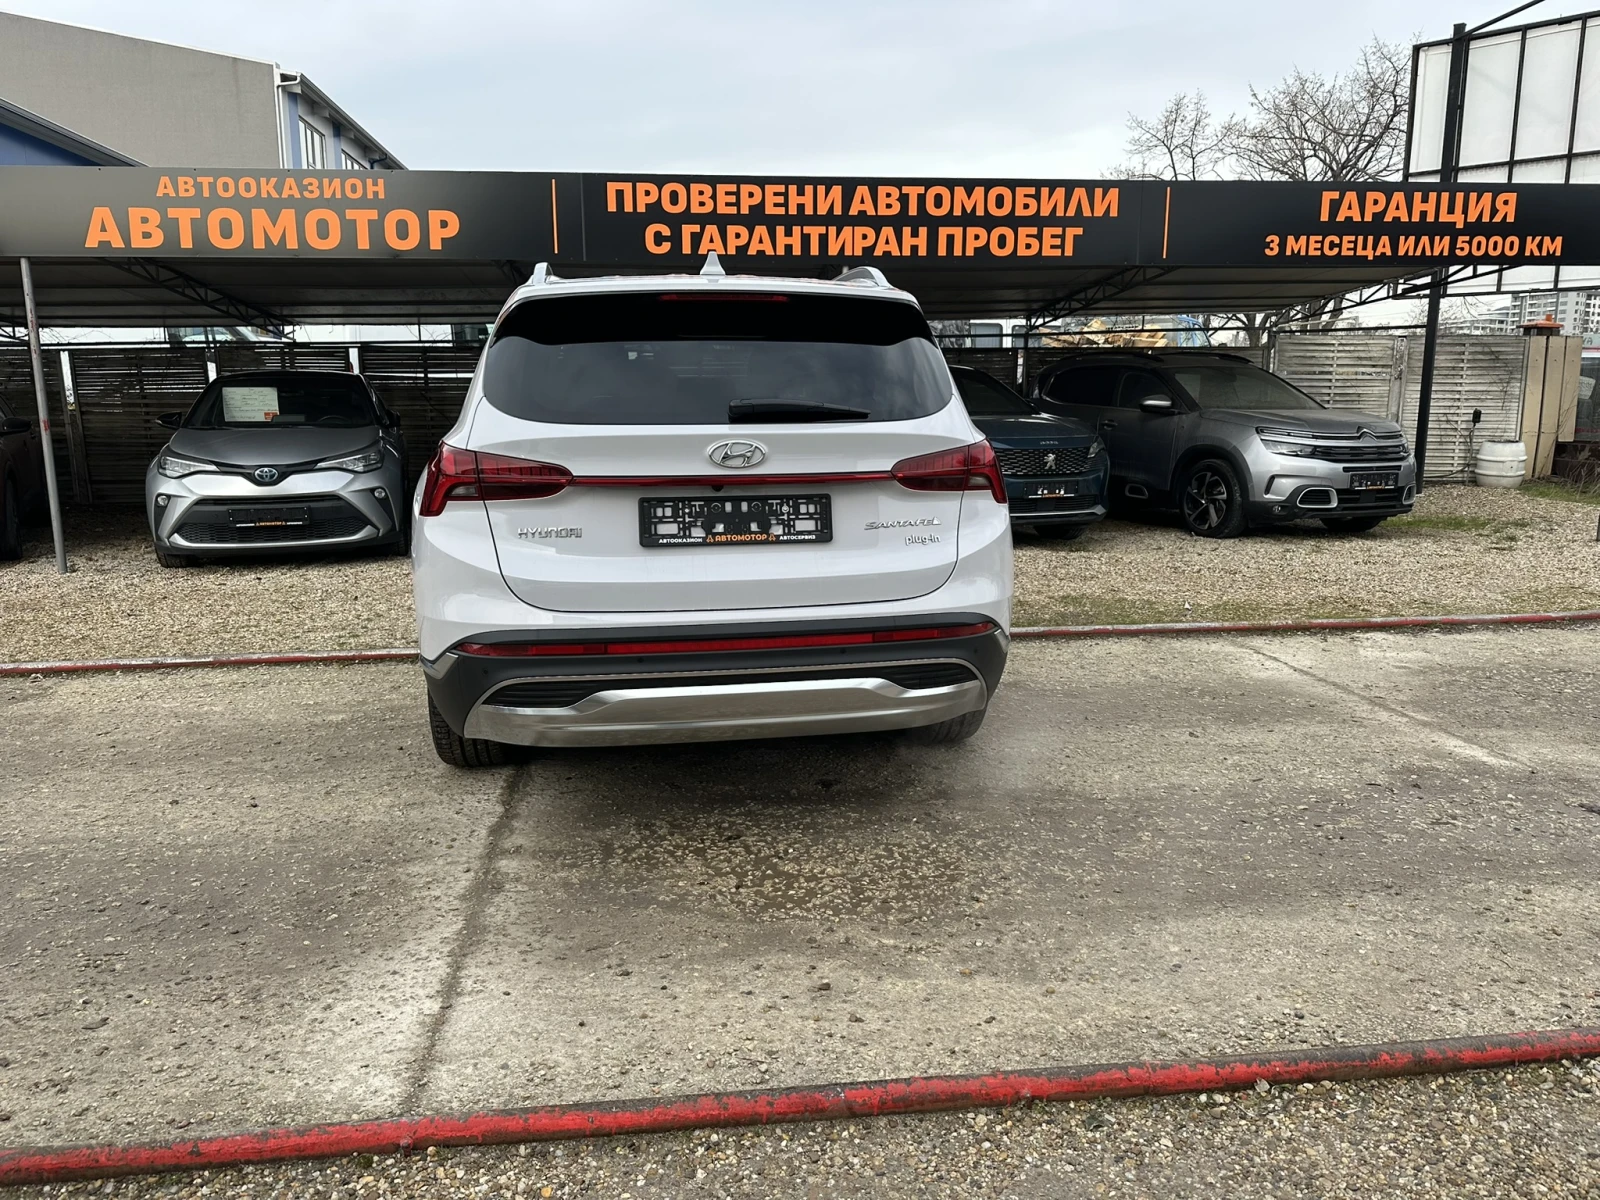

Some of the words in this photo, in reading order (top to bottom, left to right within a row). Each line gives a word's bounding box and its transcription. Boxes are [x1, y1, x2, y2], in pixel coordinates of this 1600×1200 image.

[157, 176, 385, 199] АВТООКАЗИОН
[606, 182, 842, 215] ПРОВЕРЕНИ
[849, 185, 1119, 217] АВТОМОБИЛИ
[1319, 191, 1517, 228] ГАРАНЦИЯ
[85, 207, 461, 250] АВТОМОТОР
[645, 223, 671, 254] С
[681, 224, 928, 256] ГАРАНТИРАН
[937, 226, 1083, 256] ПРОБЕГ
[1265, 235, 1280, 256] 3
[1286, 235, 1392, 260] МЕСЕЦА
[1397, 235, 1450, 256] ИЛИ
[1455, 235, 1520, 256] 5000
[1524, 236, 1563, 256] КМ
[517, 527, 583, 539] HYUNDAI
[715, 534, 768, 542] АВТОМОТОР
[905, 534, 941, 546] plug-in
